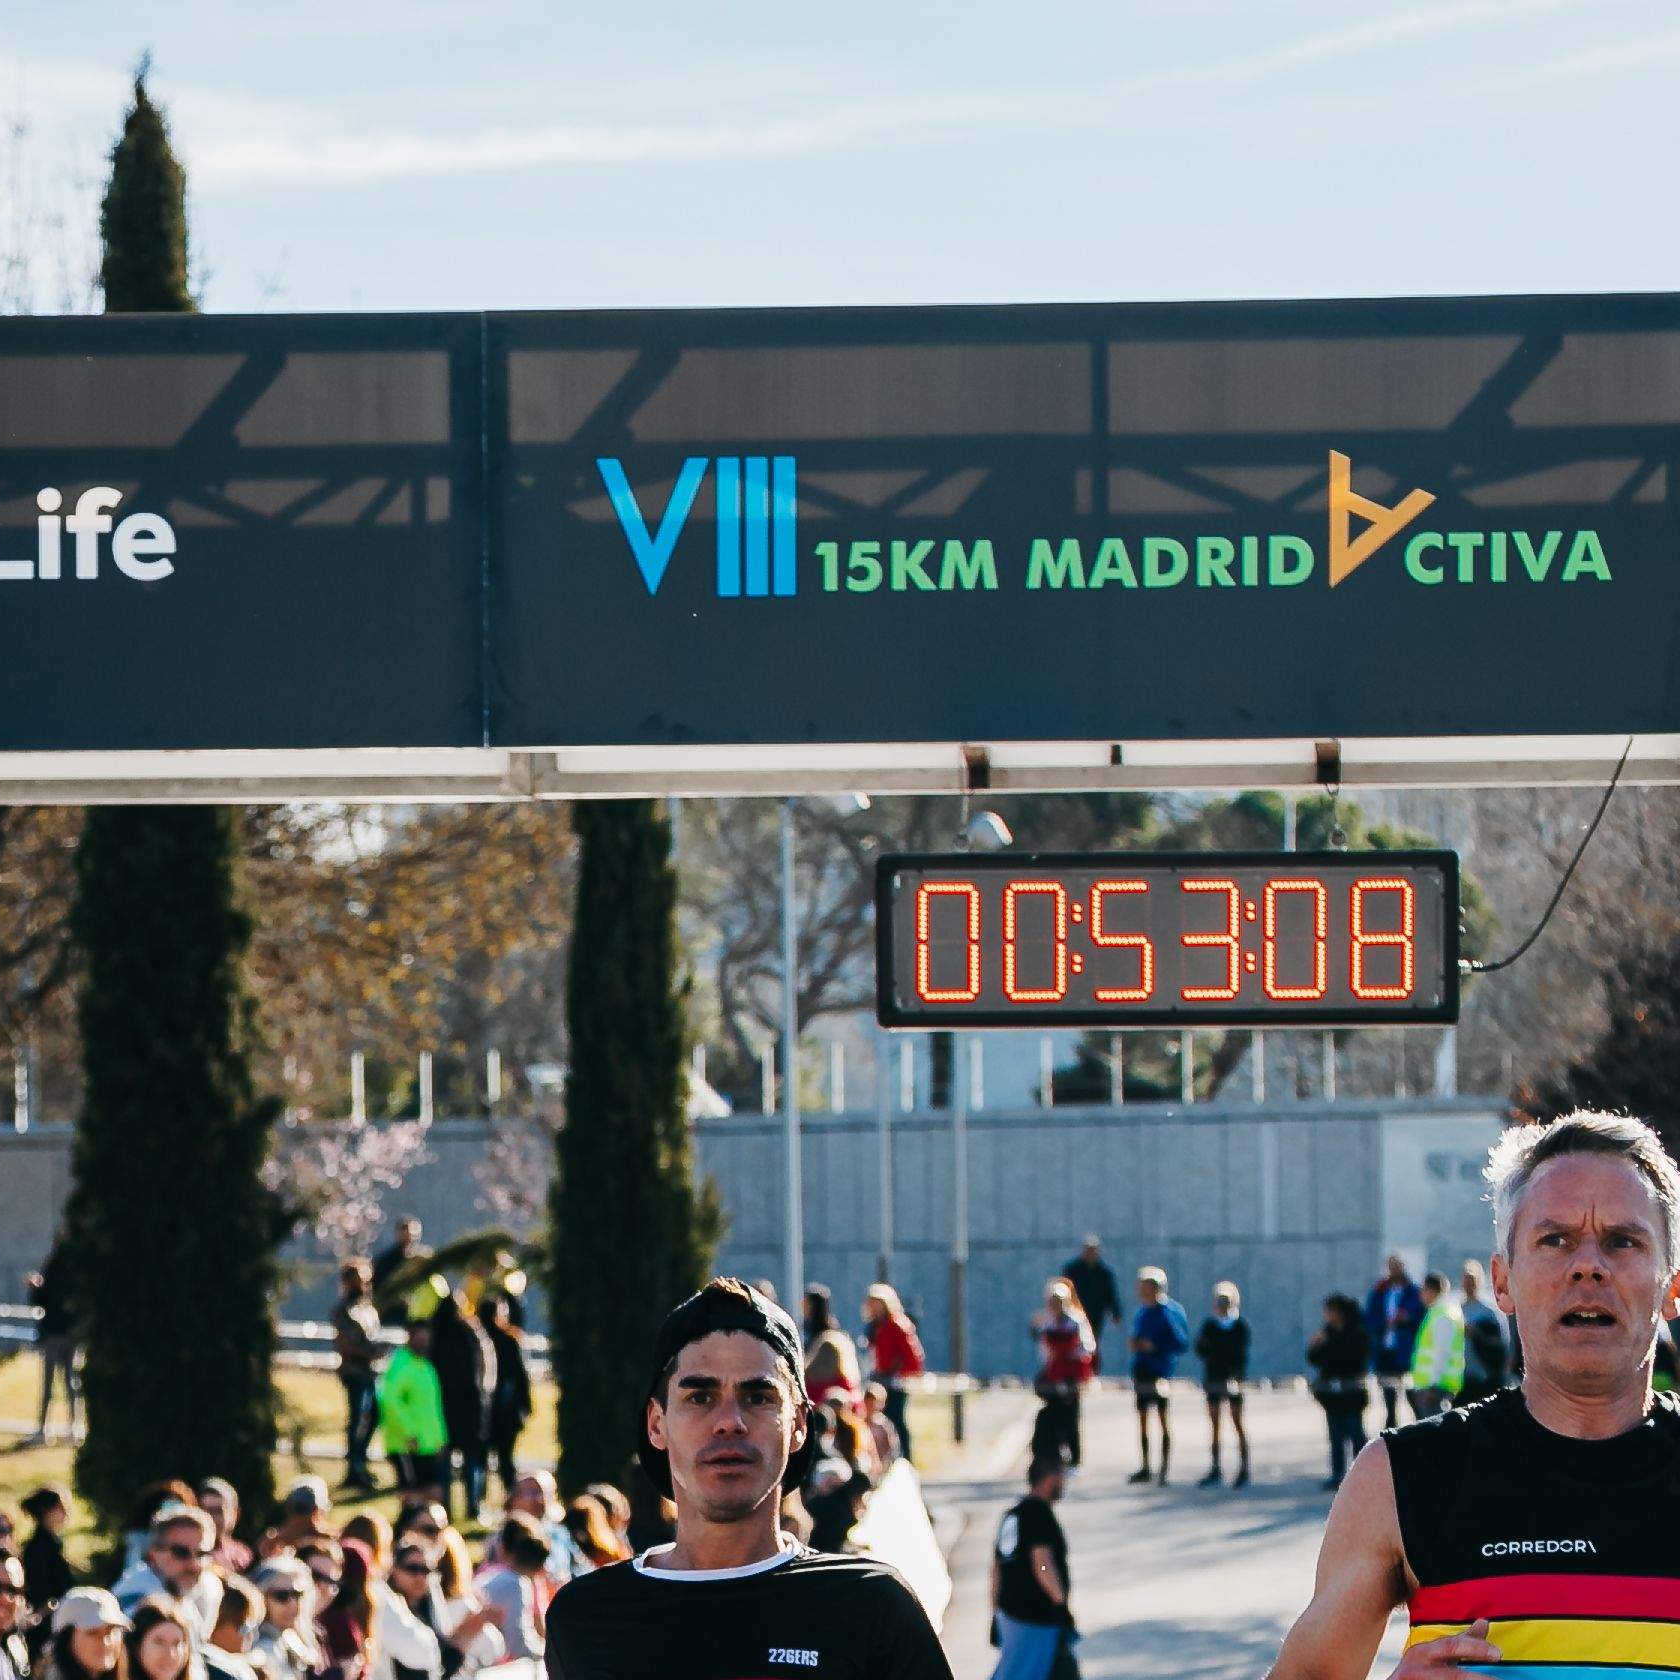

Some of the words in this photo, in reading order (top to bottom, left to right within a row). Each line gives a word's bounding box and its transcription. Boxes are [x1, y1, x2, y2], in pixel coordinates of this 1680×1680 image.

[596, 455, 797, 598] VIII
[814, 539, 1000, 593] 15KM
[915, 877, 1416, 1003] 00:53:08
[768, 1647, 819, 1667] 226ERS
